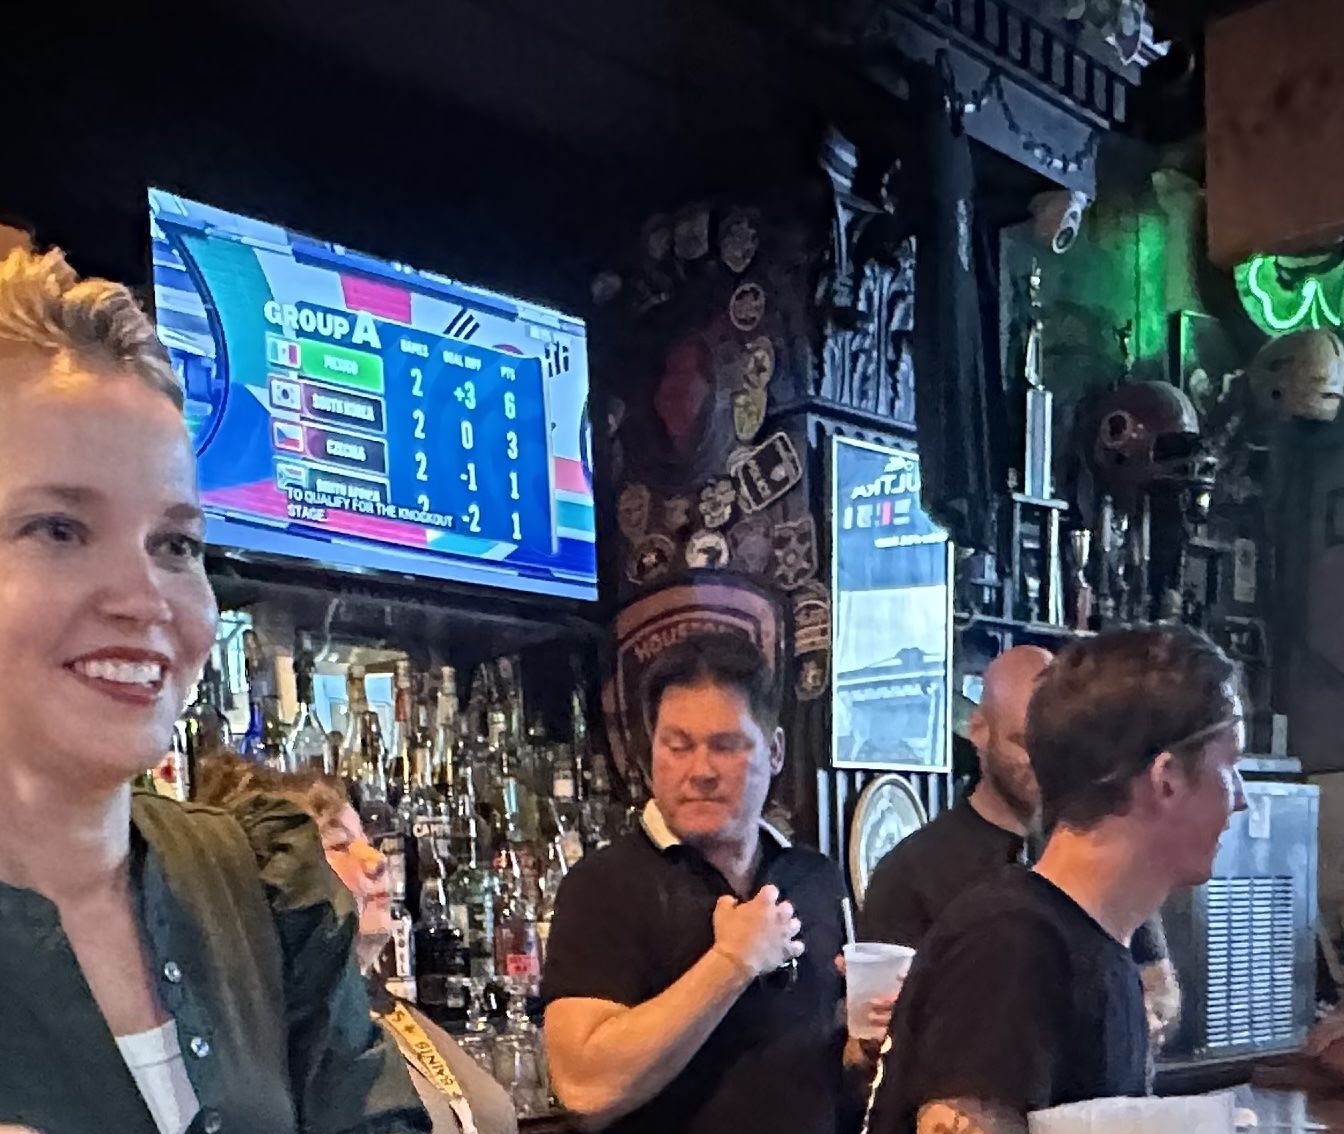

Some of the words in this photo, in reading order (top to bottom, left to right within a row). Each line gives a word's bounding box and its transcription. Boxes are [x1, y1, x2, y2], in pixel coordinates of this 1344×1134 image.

[264, 300, 350, 339] GROUP
[352, 310, 382, 349] A
[410, 367, 424, 397] 2
[453, 380, 477, 410] +3
[504, 391, 516, 420] 6
[412, 408, 426, 440] 2
[460, 419, 474, 450] 0
[506, 430, 518, 460] 3
[304, 490, 350, 510] QUALIFY
[414, 451, 428, 481] 2
[460, 462, 478, 492] -1
[509, 471, 520, 500] 1
[461, 503, 481, 532] -2
[512, 511, 522, 540] 1
